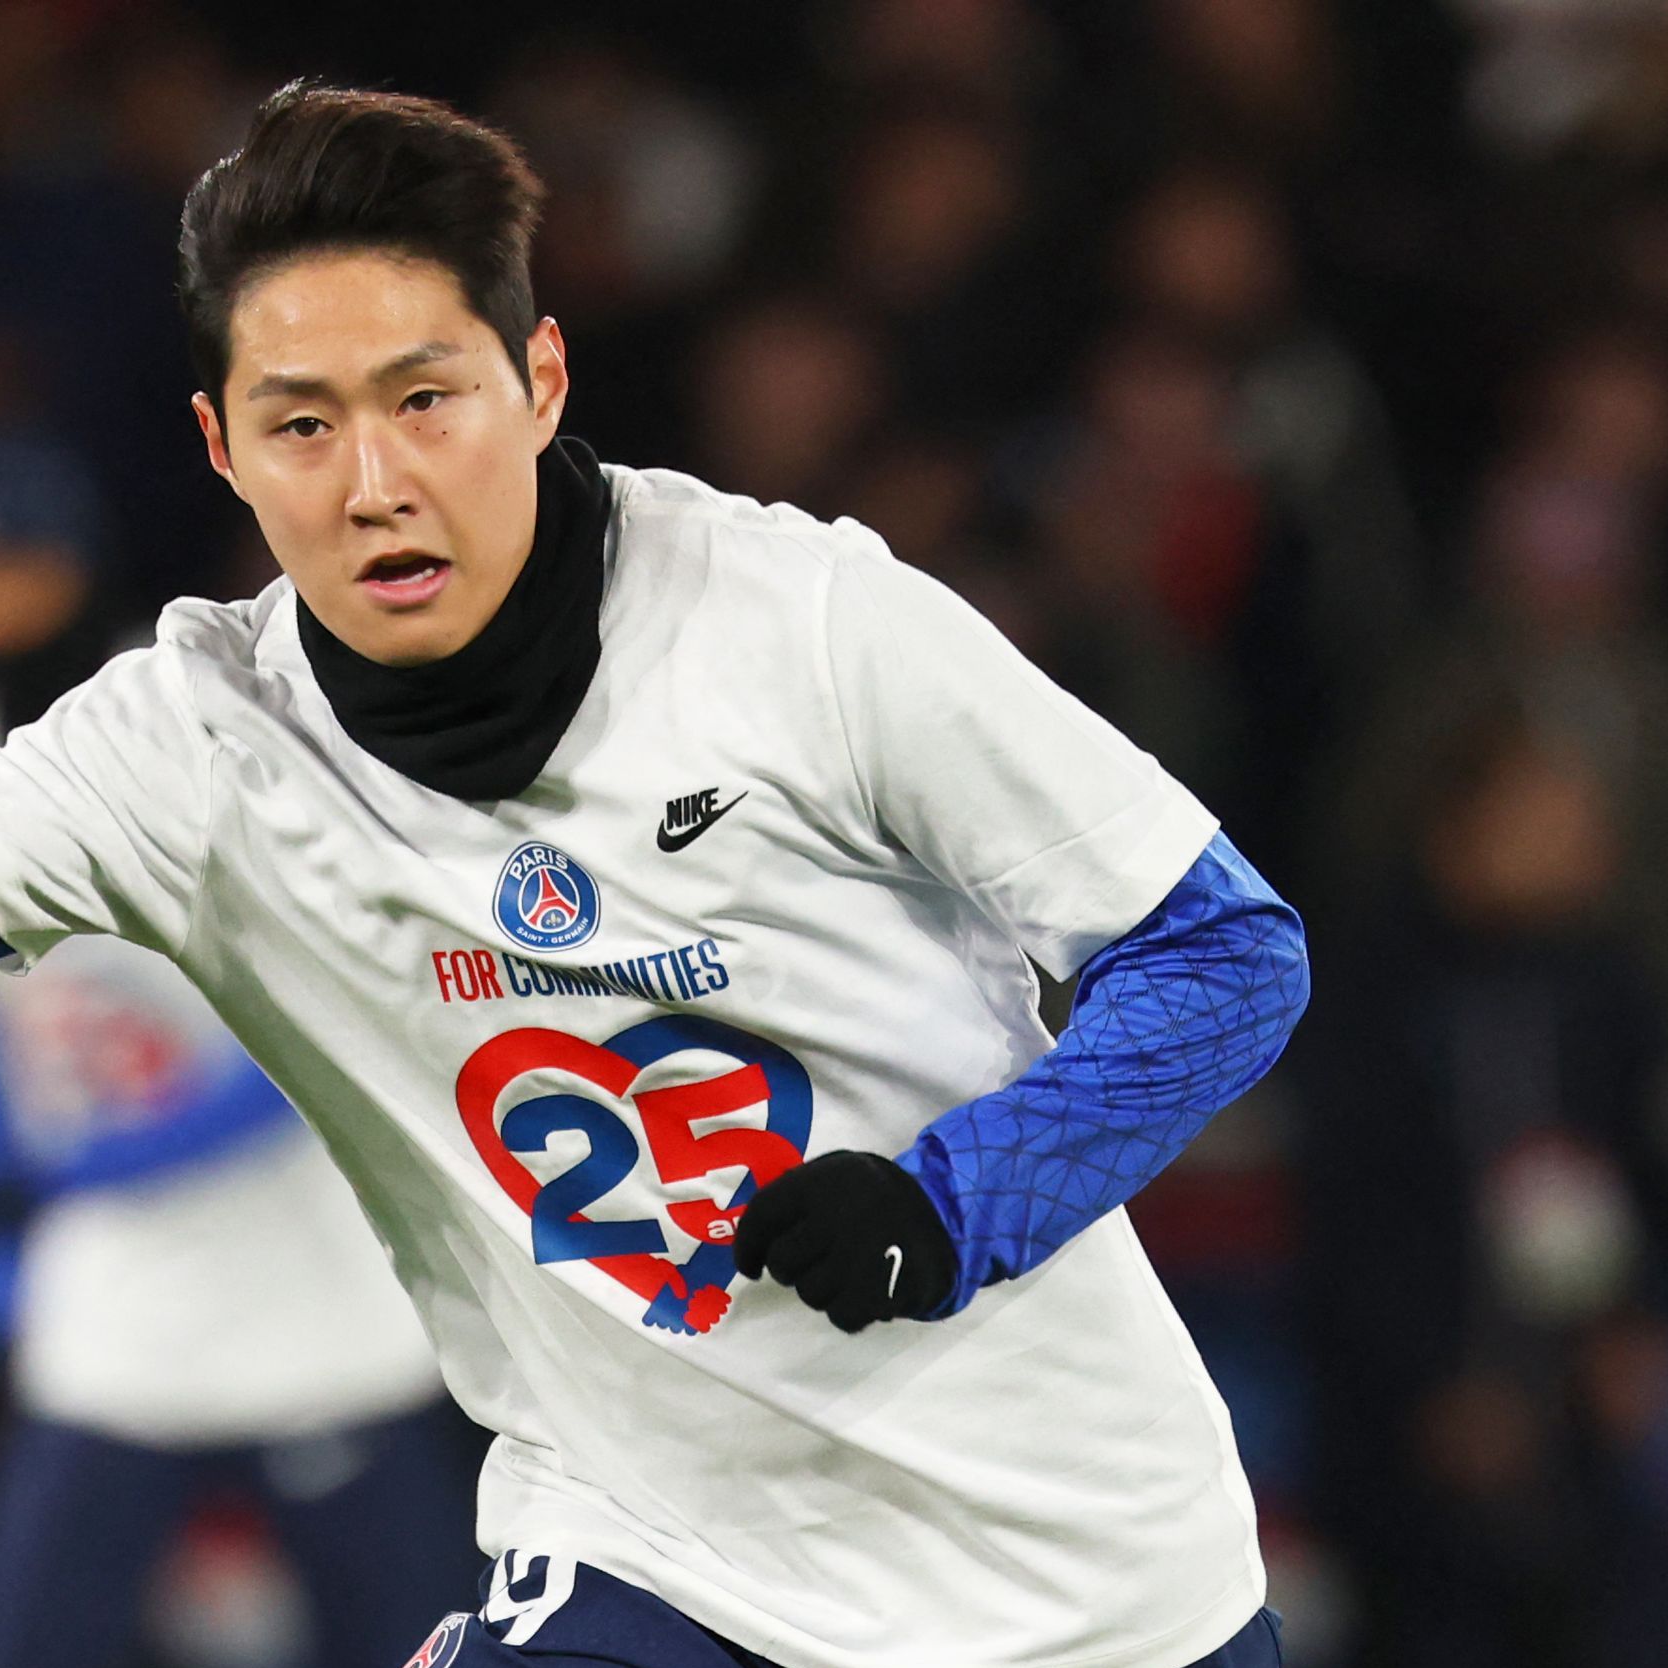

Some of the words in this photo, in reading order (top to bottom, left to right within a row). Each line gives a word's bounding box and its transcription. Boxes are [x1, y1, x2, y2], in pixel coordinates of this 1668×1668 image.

[666, 786, 719, 831] NIKE
[509, 847, 569, 881] PARIS
[515, 926, 544, 943] SAINT
[550, 916, 589, 943] GERMAIN
[432, 949, 505, 1003] FOR
[502, 937, 730, 1002] COMMUNITIES
[500, 1063, 805, 1264] 25
